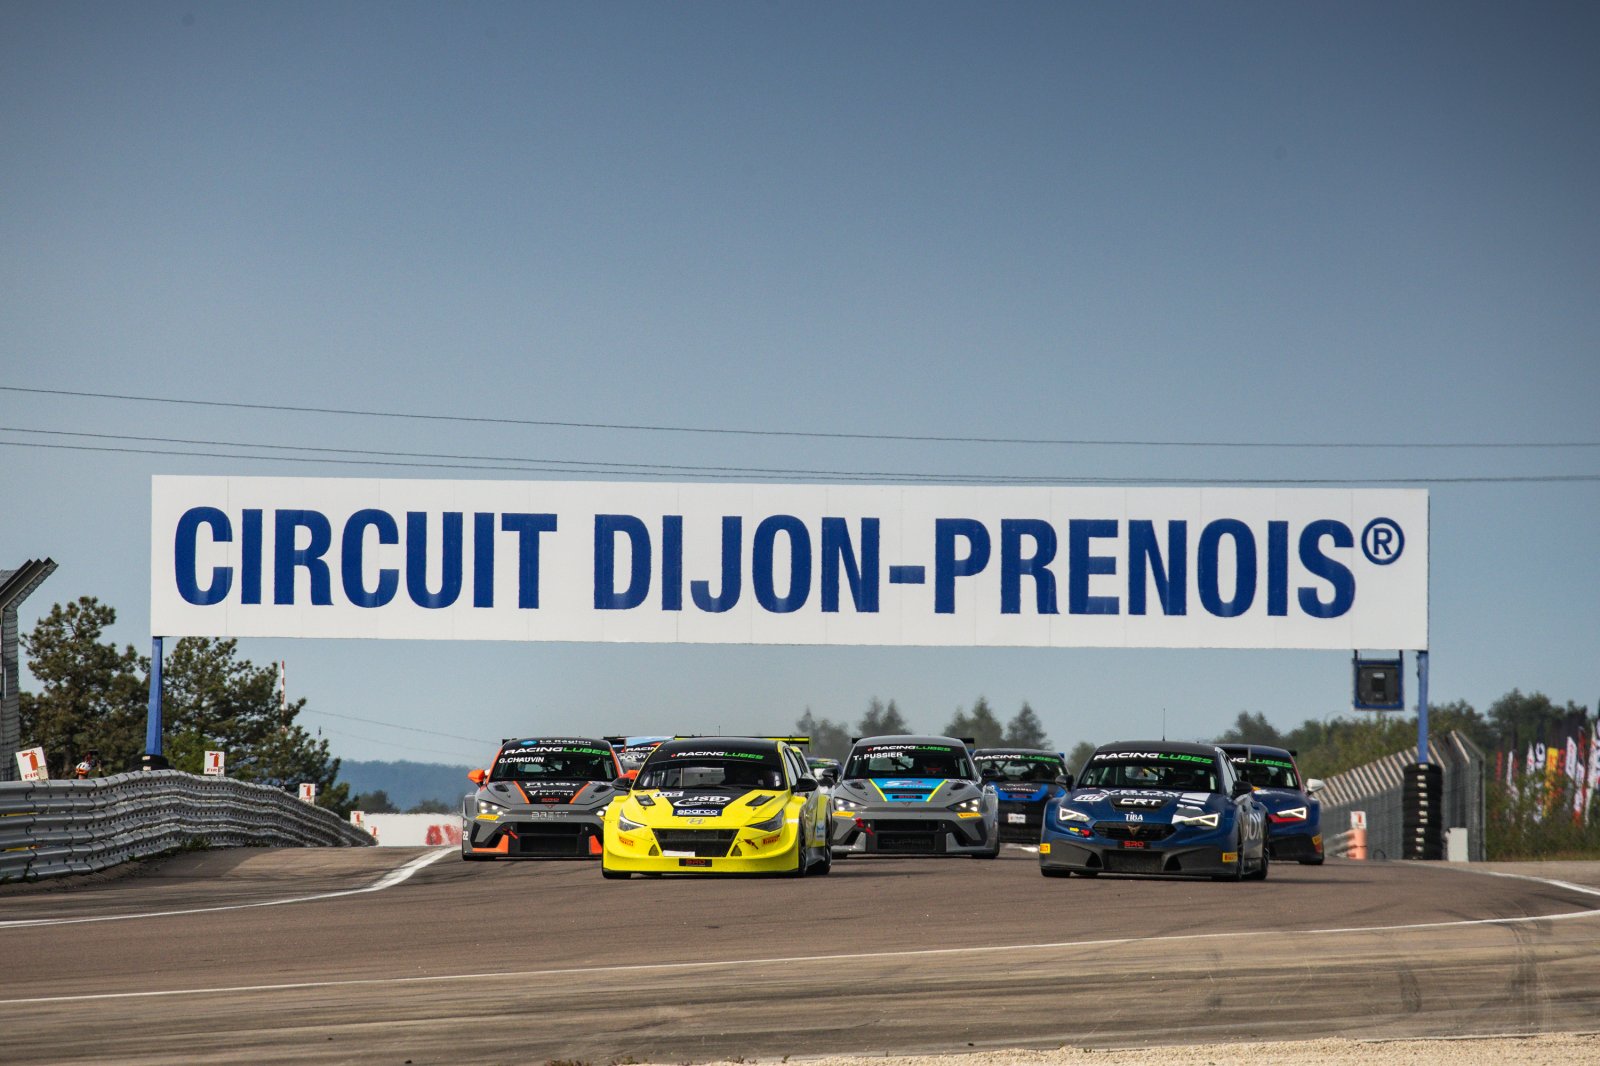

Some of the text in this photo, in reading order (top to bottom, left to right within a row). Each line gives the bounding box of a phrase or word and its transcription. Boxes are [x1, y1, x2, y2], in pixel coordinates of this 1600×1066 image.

[174, 506, 558, 609] CIRCUIT
[863, 751, 904, 760] PUSSIER
[1120, 798, 1162, 806] CRT
